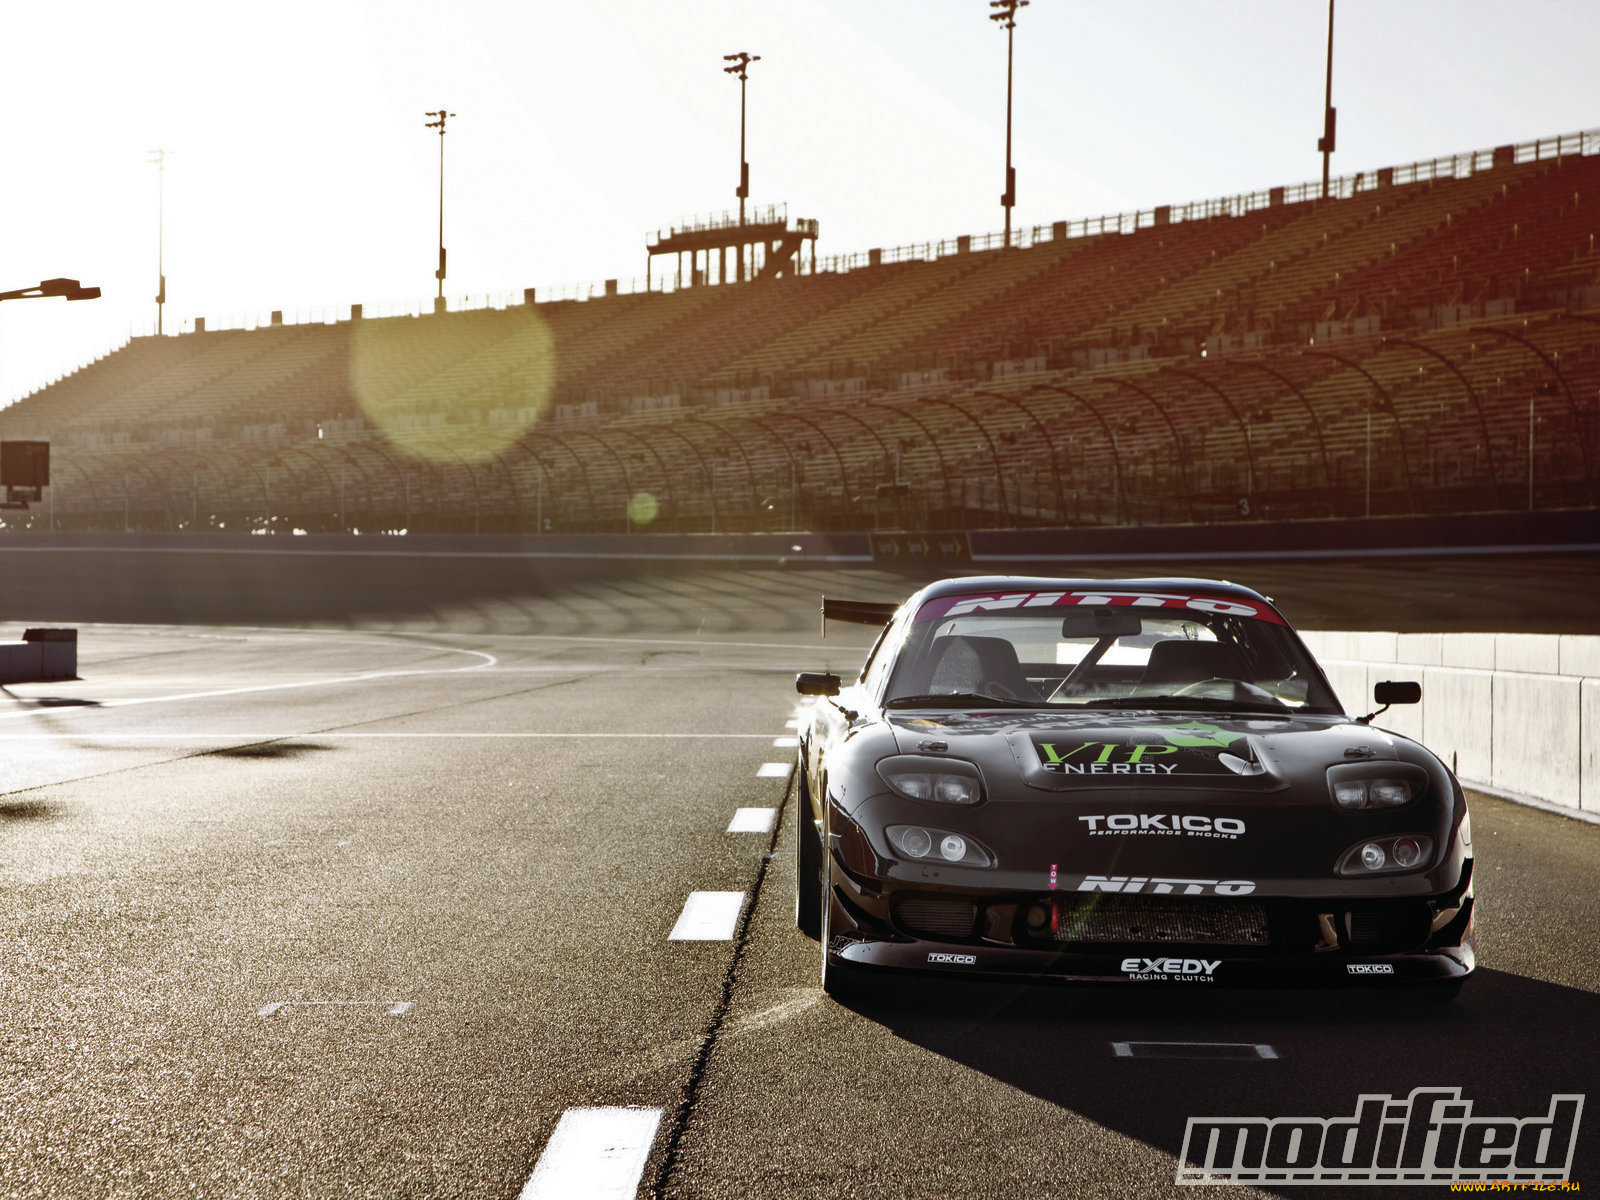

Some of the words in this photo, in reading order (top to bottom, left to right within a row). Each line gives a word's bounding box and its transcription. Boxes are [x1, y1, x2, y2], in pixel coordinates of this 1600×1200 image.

[944, 591, 1258, 616] NITTO
[1039, 742, 1178, 764] VIP
[1043, 763, 1178, 775] ENERGY
[1078, 814, 1246, 835] TOKICO
[1187, 831, 1237, 840] SHOCKS
[1077, 875, 1256, 896] NITTO
[929, 953, 975, 964] TOKICO
[1121, 957, 1222, 975] EXEDY
[1348, 964, 1393, 974] TOKICO
[1129, 973, 1168, 981] RACING
[1174, 974, 1214, 983] CLUTCH
